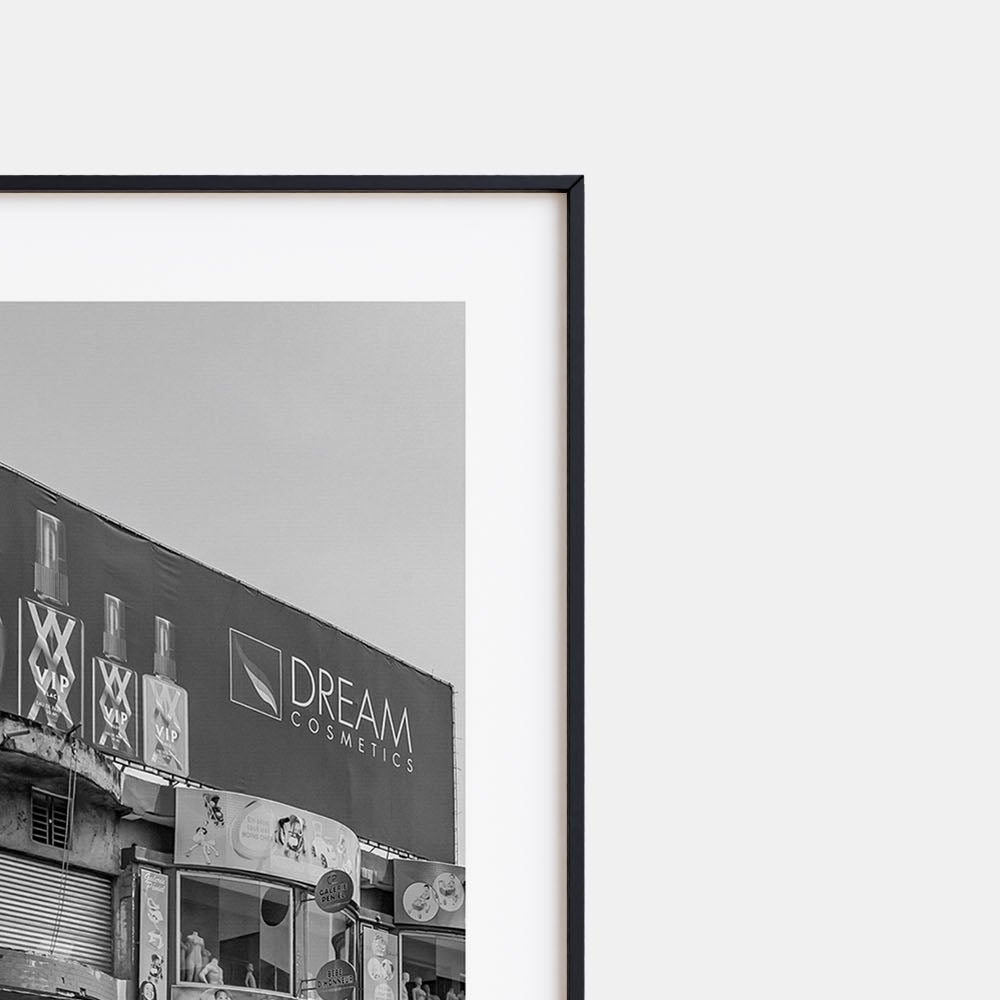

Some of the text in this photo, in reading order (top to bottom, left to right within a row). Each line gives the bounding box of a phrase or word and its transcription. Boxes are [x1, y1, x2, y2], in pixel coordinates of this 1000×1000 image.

[34, 664, 70, 693] VIP
[104, 705, 128, 725] VIP
[291, 656, 413, 754] DREAM
[155, 724, 178, 743] VIP
[290, 711, 414, 773] COSMETICS
